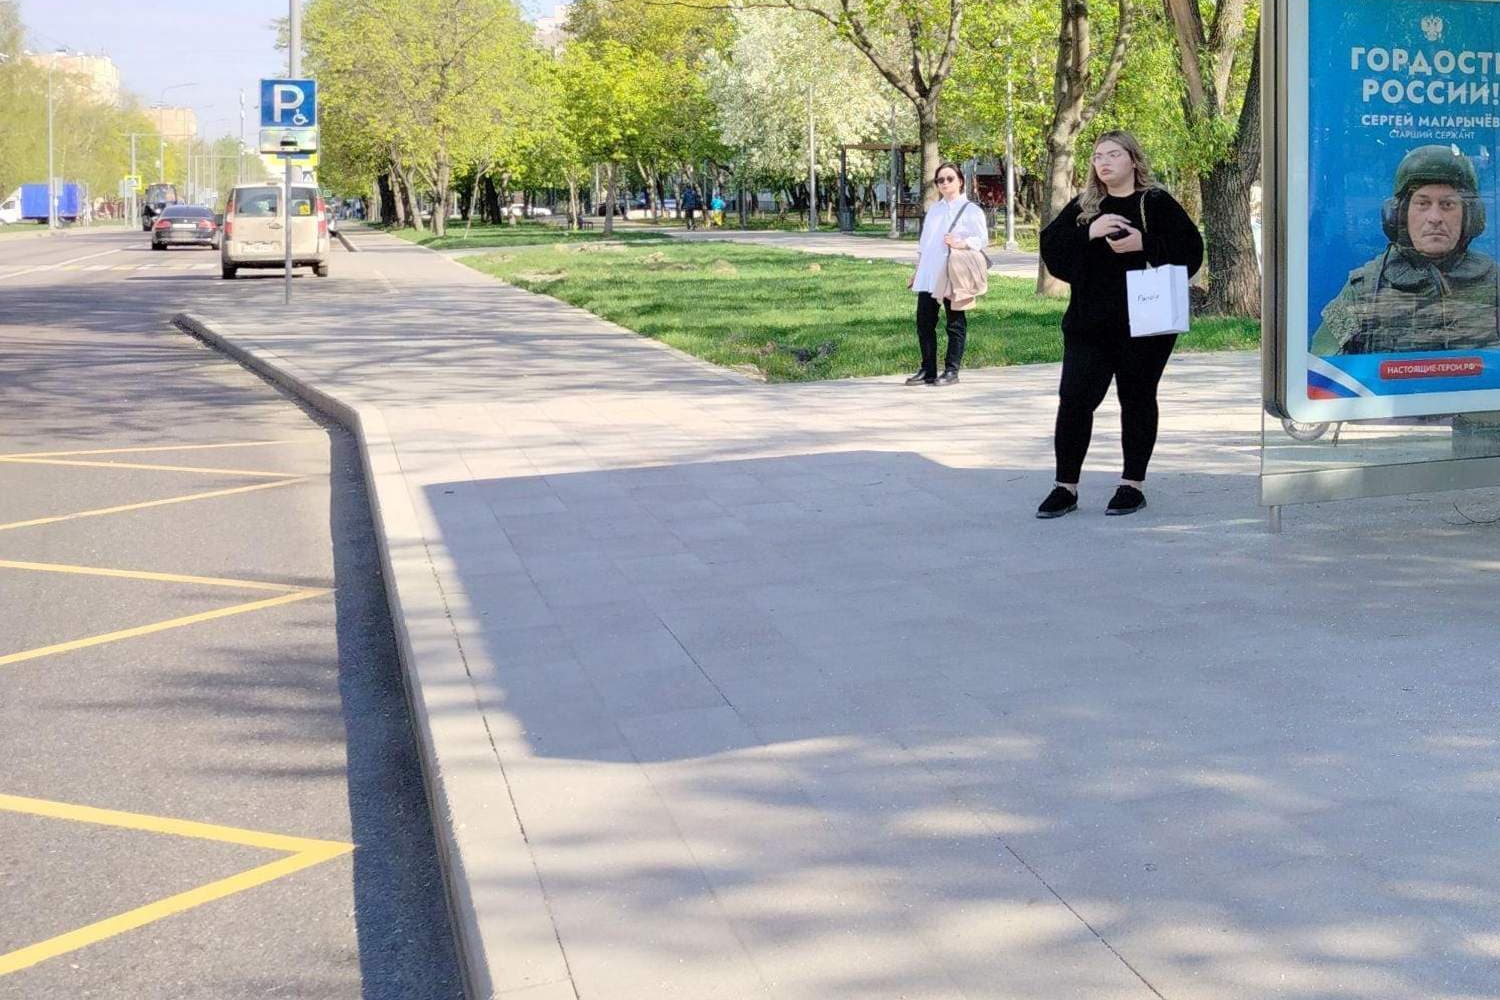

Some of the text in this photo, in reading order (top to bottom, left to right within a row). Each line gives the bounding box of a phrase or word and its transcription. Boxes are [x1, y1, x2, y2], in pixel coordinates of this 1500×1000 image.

[1362, 79, 1500, 106] РОССИИ!
[273, 84, 305, 123] P
[1361, 112, 1500, 128] СЕРГЕЙ МАГАРЫЧЁВ
[1435, 129, 1475, 140] СЕРЖАНТ
